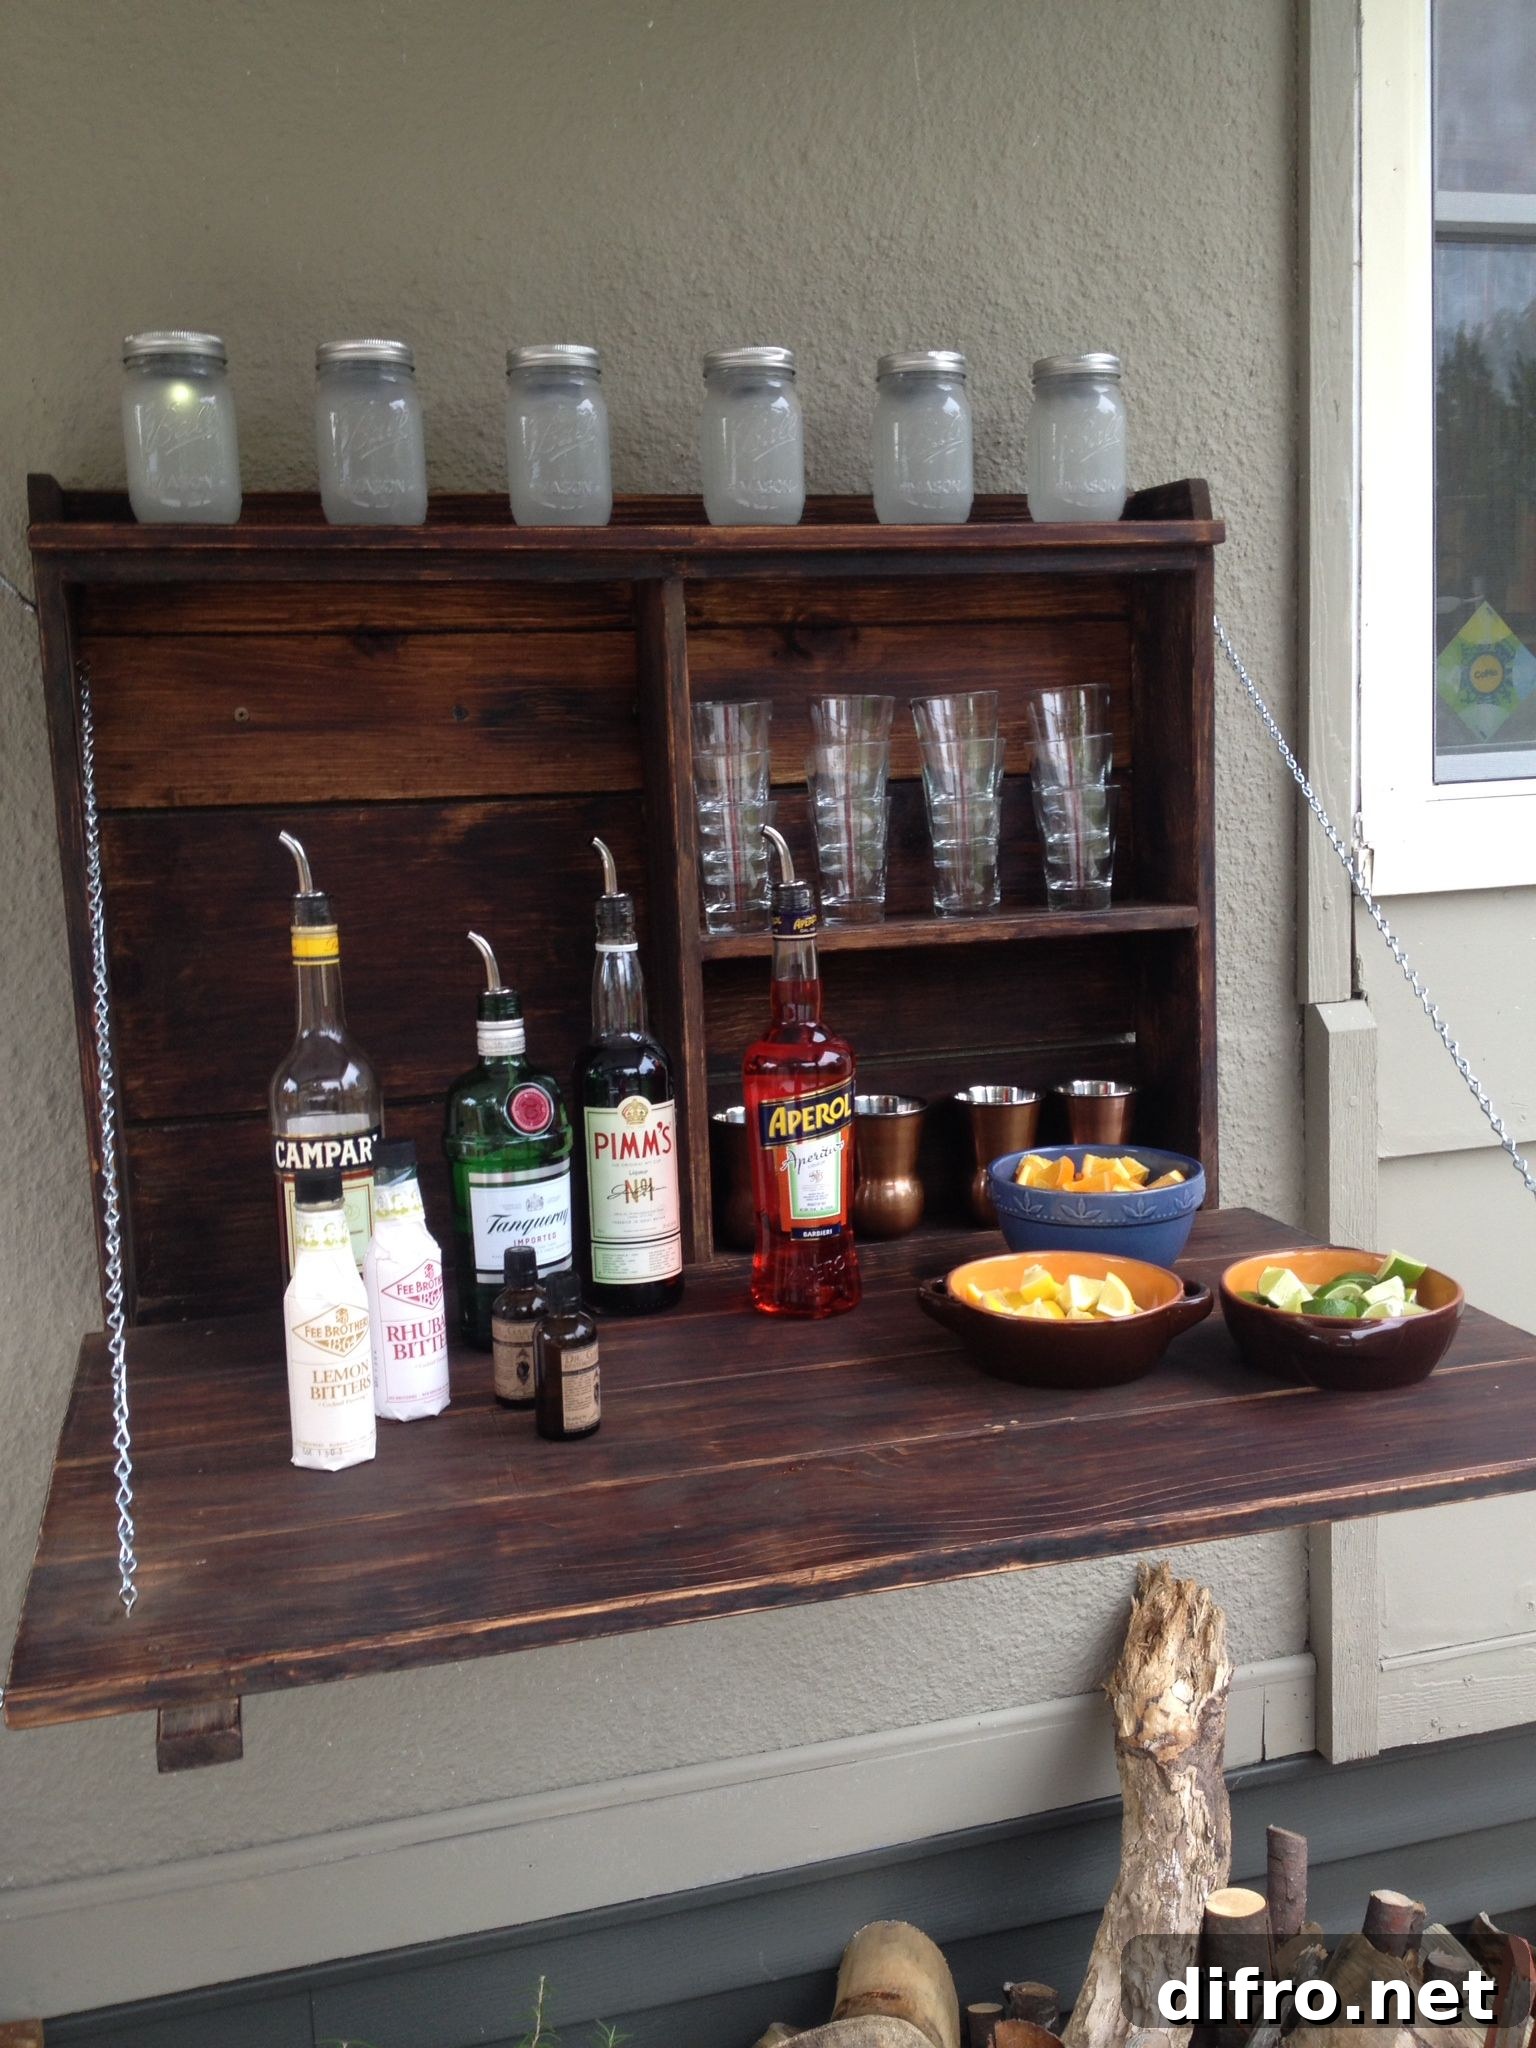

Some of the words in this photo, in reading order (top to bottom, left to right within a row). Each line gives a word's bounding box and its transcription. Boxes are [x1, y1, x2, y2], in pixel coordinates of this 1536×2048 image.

[768, 1093, 852, 1138] APEROL
[275, 1133, 378, 1170] CAMPAR
[594, 1121, 672, 1161] PIMM'S
[487, 1208, 569, 1237] Tanqueray
[513, 1232, 557, 1247] IMPORTED
[397, 1285, 415, 1295] FEE
[305, 1326, 322, 1338] FEE
[312, 1359, 369, 1384] LEMON
[310, 1375, 371, 1401] BITTERS
